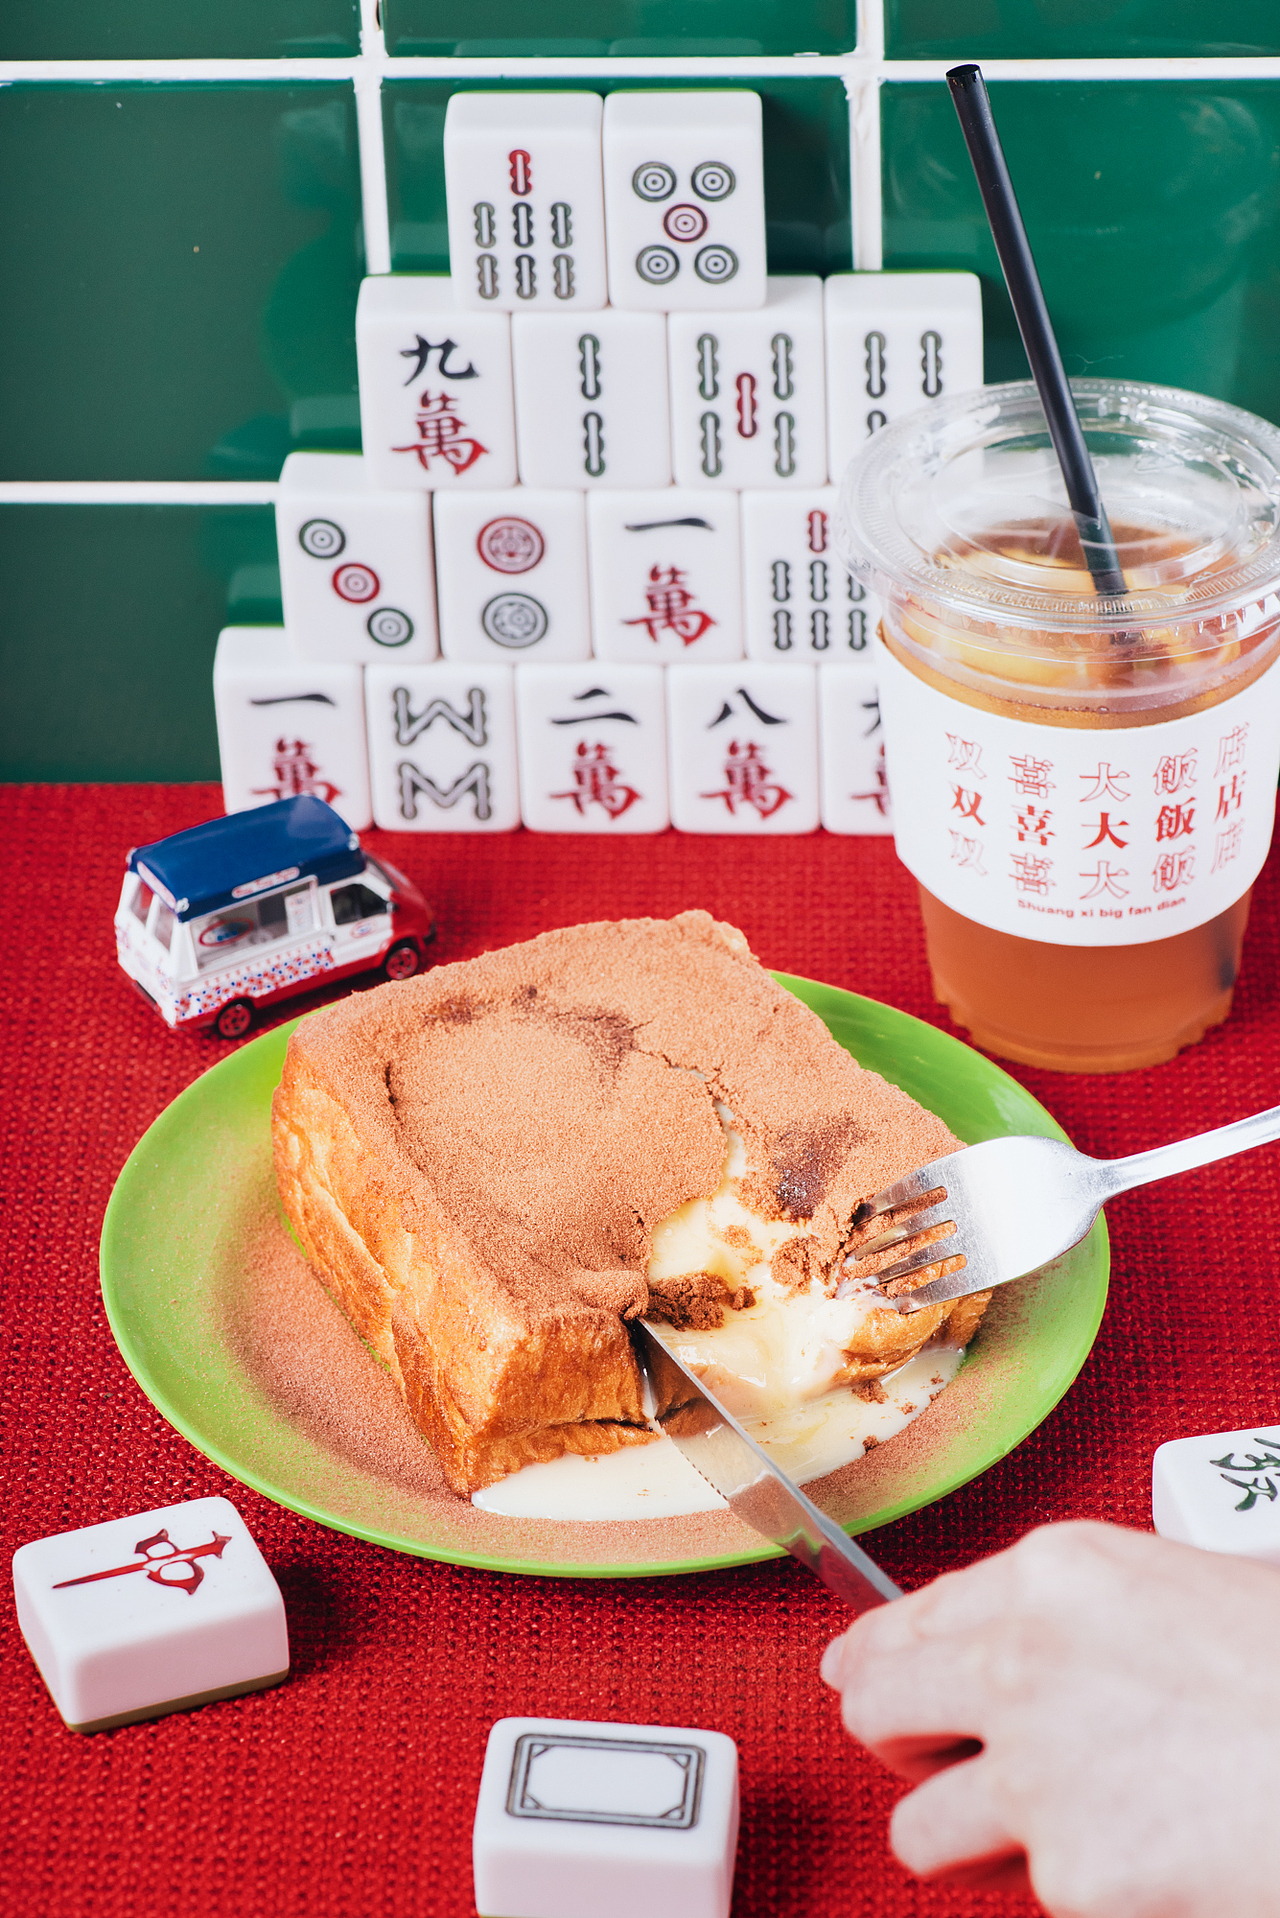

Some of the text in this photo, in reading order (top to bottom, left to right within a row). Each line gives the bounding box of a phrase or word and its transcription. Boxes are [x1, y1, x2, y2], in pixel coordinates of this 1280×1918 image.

[391, 334, 489, 475] 九萬
[623, 517, 719, 647] 一萬
[549, 687, 642, 819] 二萬
[700, 687, 794, 820] 八萬
[1017, 897, 1186, 919] Shuang xi big fan dian
